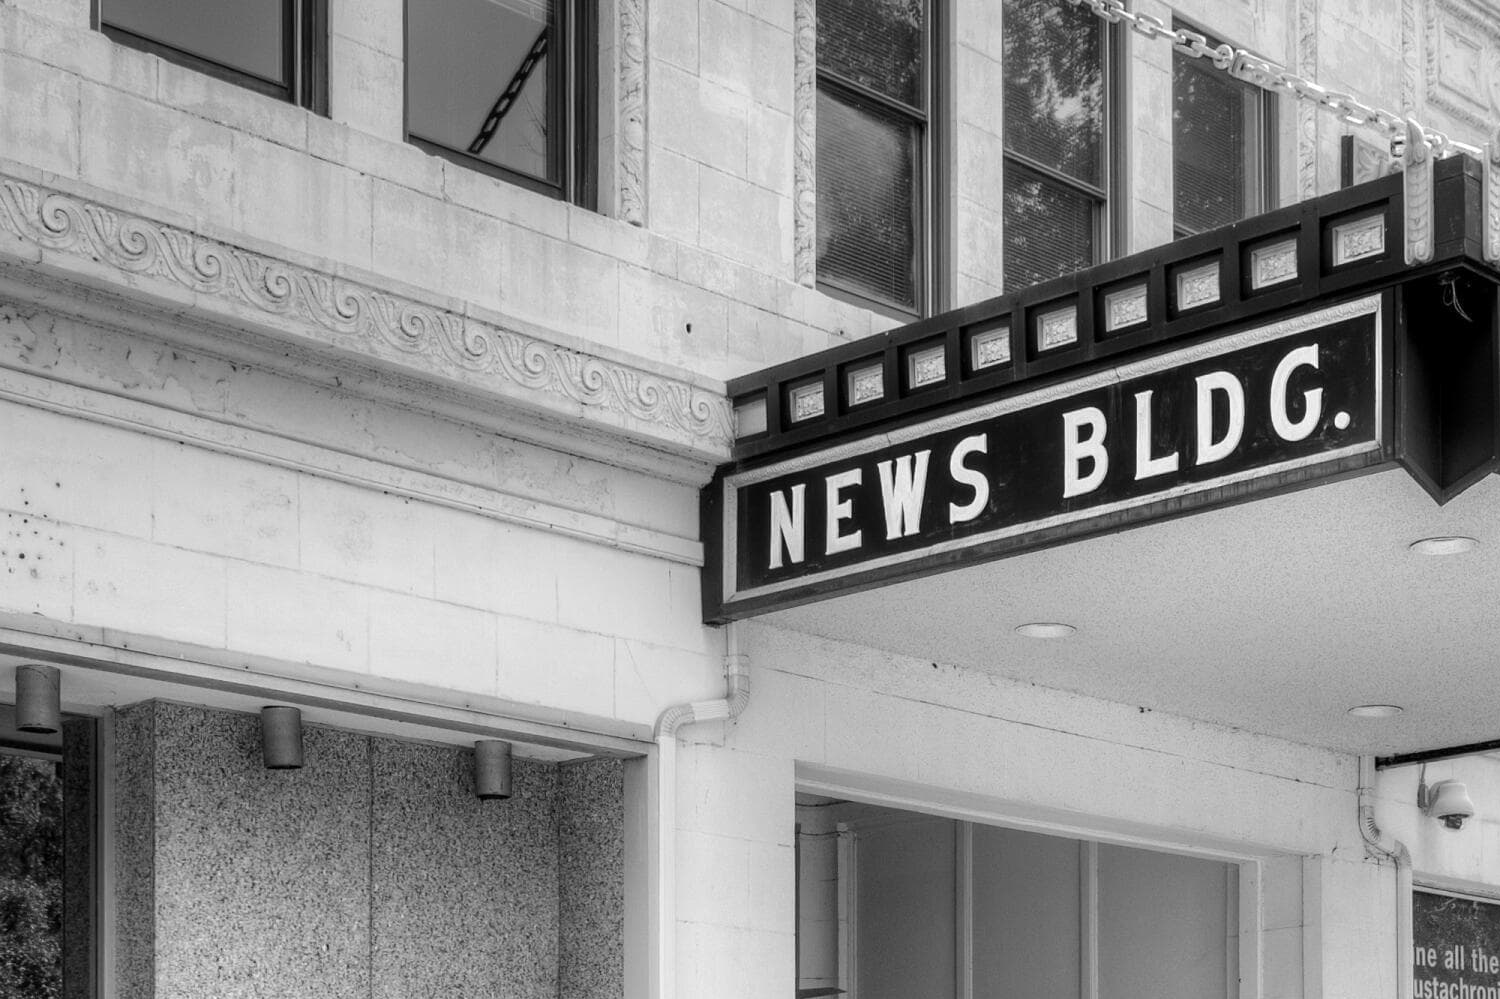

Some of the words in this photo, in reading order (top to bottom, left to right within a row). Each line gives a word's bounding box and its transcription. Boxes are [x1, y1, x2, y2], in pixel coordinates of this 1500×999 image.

[769, 433, 991, 570] NEWS
[1062, 343, 1351, 499] BLDG.
[1413, 945, 1437, 967] ne
[1444, 945, 1465, 971] all
[1471, 947, 1500, 975] the
